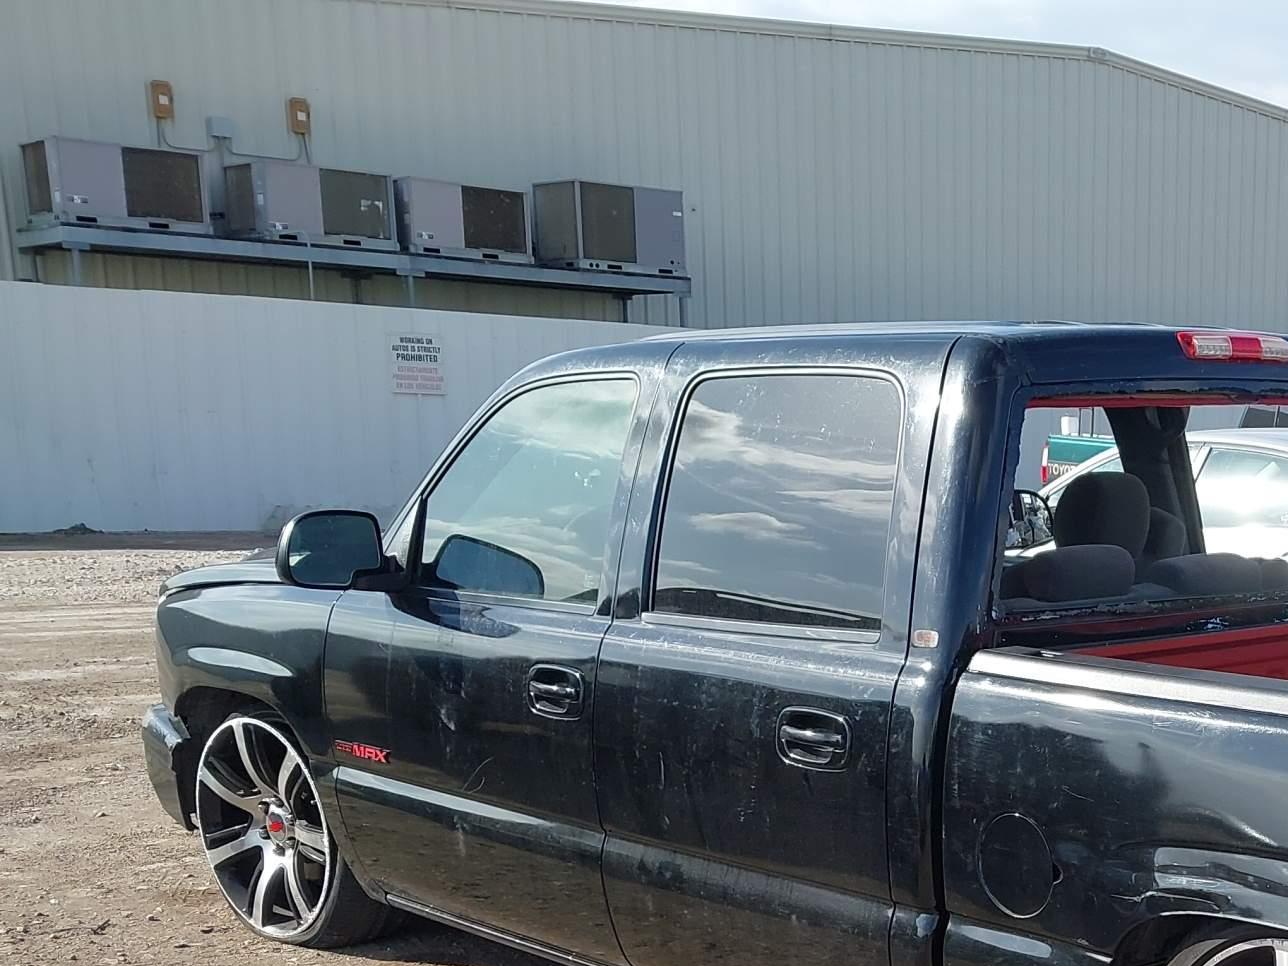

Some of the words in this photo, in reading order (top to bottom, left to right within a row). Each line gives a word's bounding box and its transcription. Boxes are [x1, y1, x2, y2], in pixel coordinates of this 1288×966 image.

[416, 346, 441, 354] STRICTLY
[396, 353, 437, 362] PROHIBITED
[1048, 463, 1077, 475] TOYO
[352, 743, 387, 763] MAX
